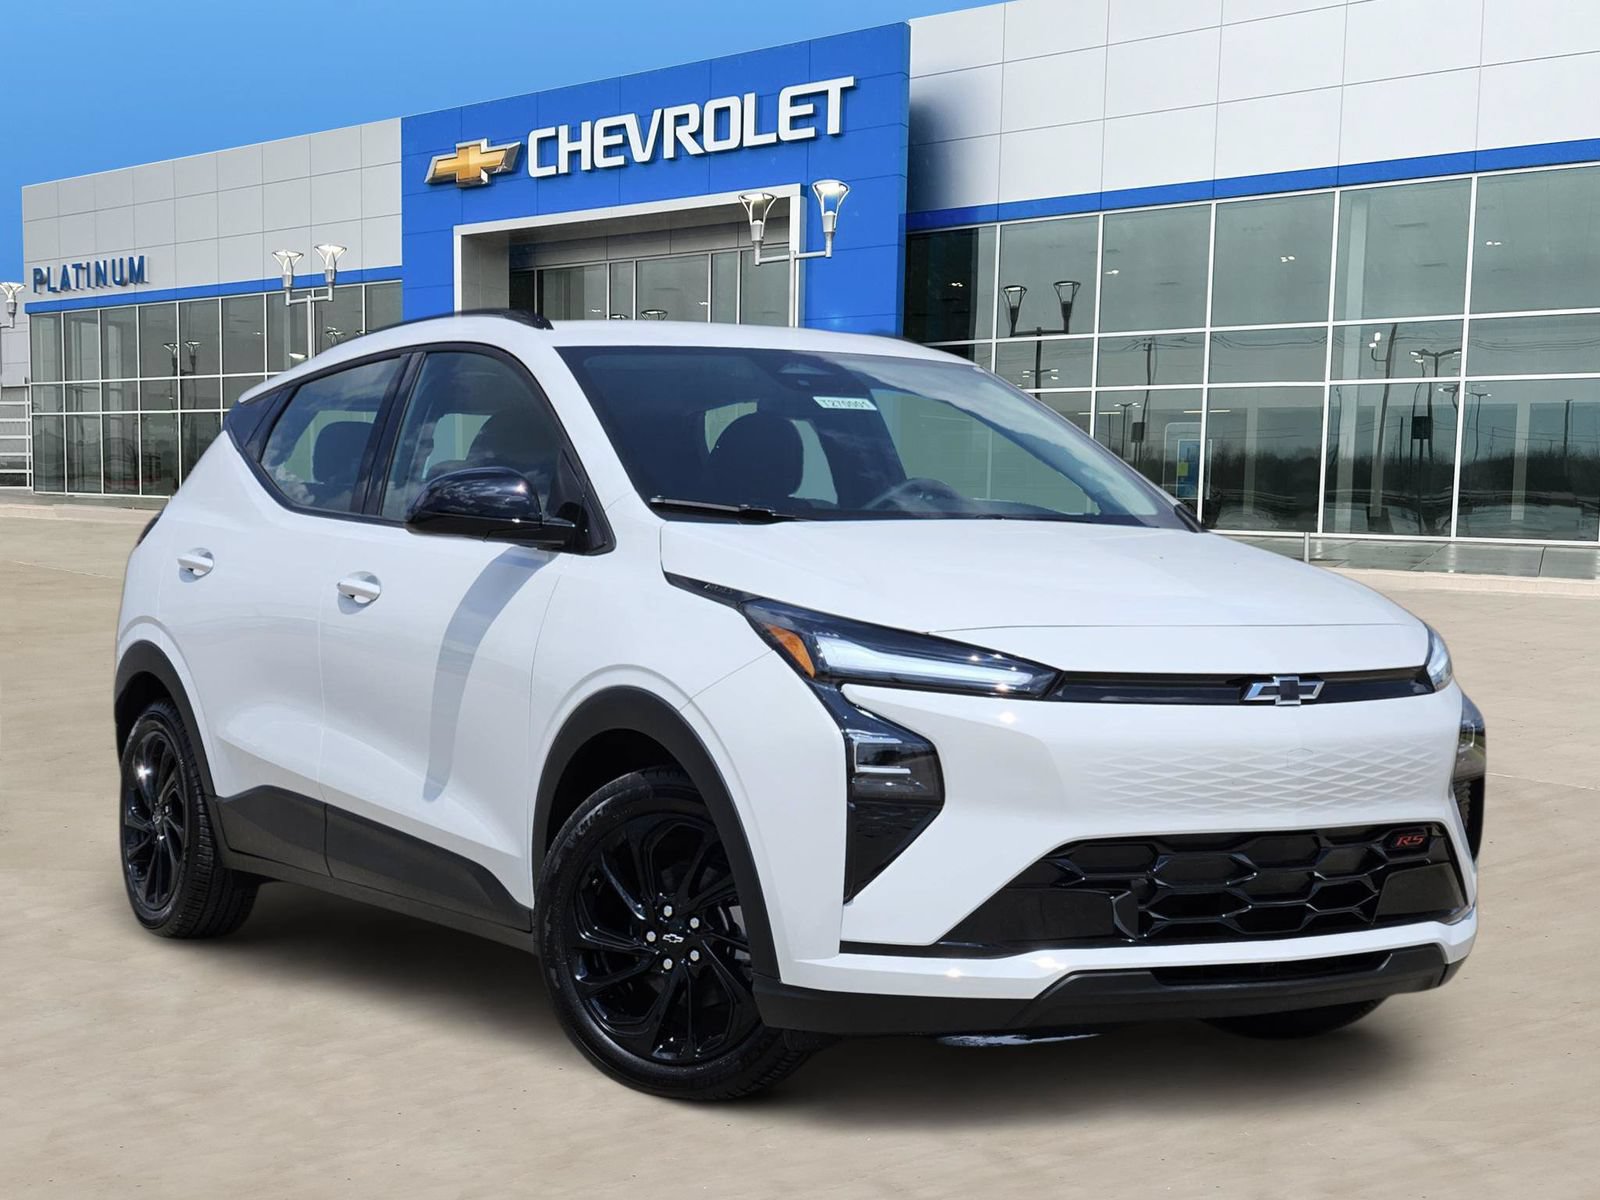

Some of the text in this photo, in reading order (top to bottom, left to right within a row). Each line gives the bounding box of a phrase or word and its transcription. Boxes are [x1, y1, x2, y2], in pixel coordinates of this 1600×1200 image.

[527, 75, 855, 178] CHEVROLET
[32, 255, 145, 293] PLATINUM
[1395, 834, 1425, 847] RS
